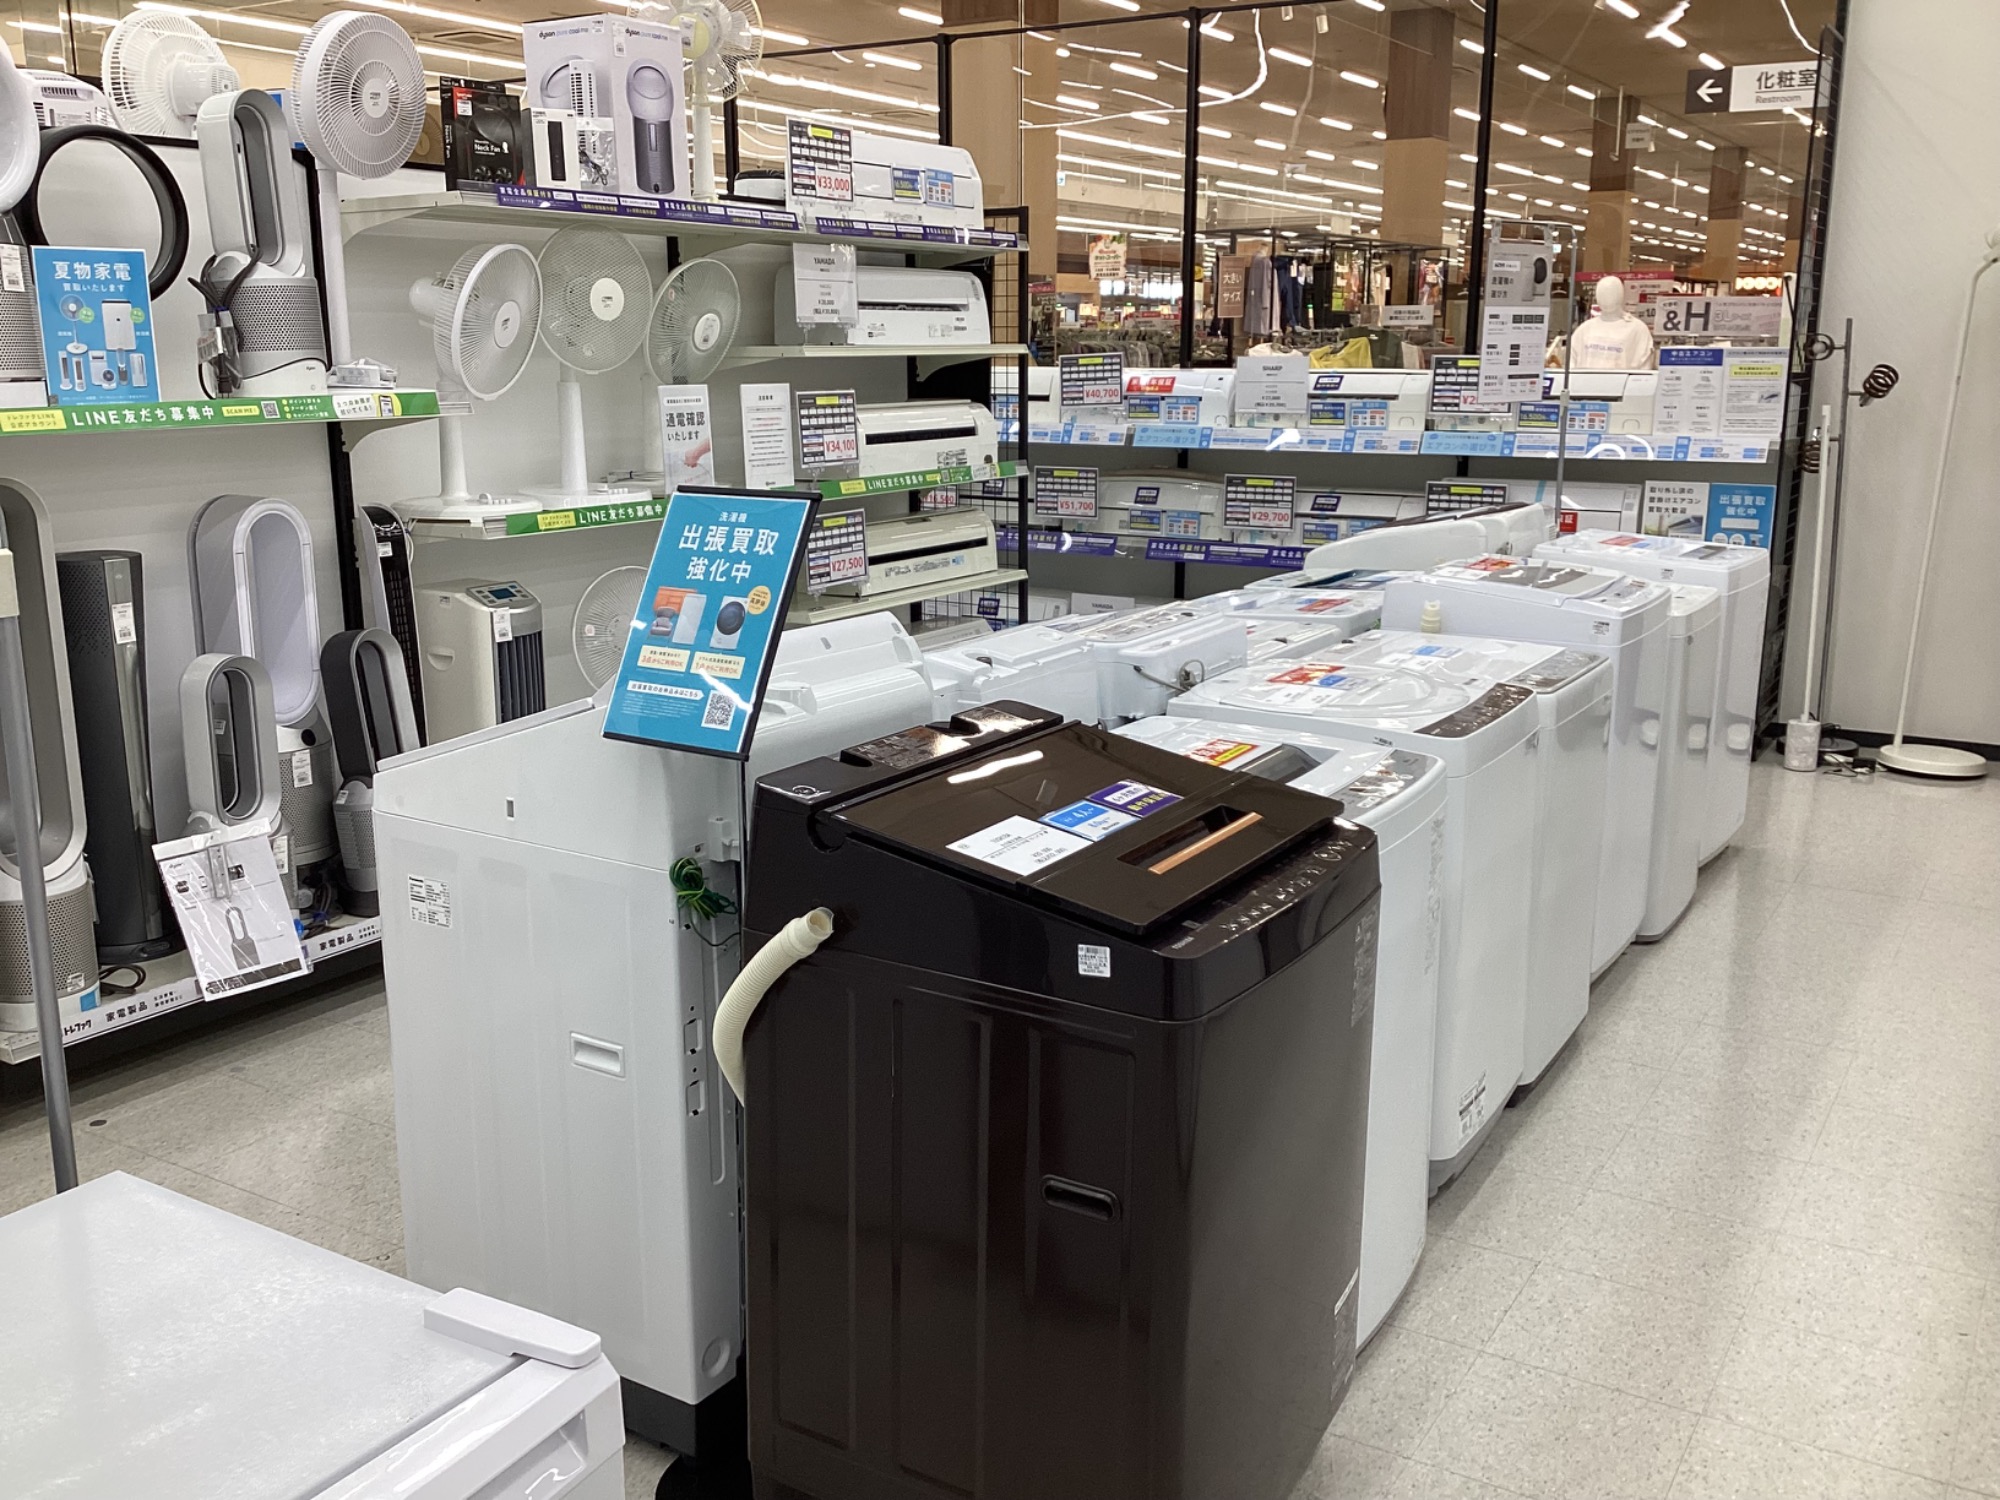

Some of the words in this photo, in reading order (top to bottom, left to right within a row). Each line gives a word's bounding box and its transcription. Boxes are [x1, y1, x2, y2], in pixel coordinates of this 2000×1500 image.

[539, 30, 555, 39] dyson
[625, 27, 640, 37] dyson
[1756, 69, 1818, 90] 化粧室
[1755, 94, 1802, 104] Restroom
[474, 143, 489, 152] Neck
[490, 145, 501, 153] Fan
[817, 175, 850, 191] ¥33,000
[52, 261, 131, 281] 夏物家電
[63, 282, 125, 292] 買取いたします
[1085, 389, 1119, 399] ¥40,700
[72, 405, 215, 427] LINE友だち募集中
[665, 411, 706, 427] 通電確認
[667, 430, 700, 441] いたします
[825, 438, 855, 453] ¥34,100
[1650, 486, 1694, 495] 取り外し済の
[1060, 501, 1094, 511] ¥51,700
[1719, 494, 1766, 506] 出張買取
[579, 503, 663, 525] LINE友だち募集中
[718, 511, 747, 523] 洗濯機
[1252, 511, 1290, 522] ¥29,700
[678, 523, 779, 556] 出張買取
[686, 556, 752, 585] 強化中
[831, 556, 864, 573] ¥27,500
[64, 1019, 92, 1036] トレファク
[105, 1001, 148, 1022] 家電製品
